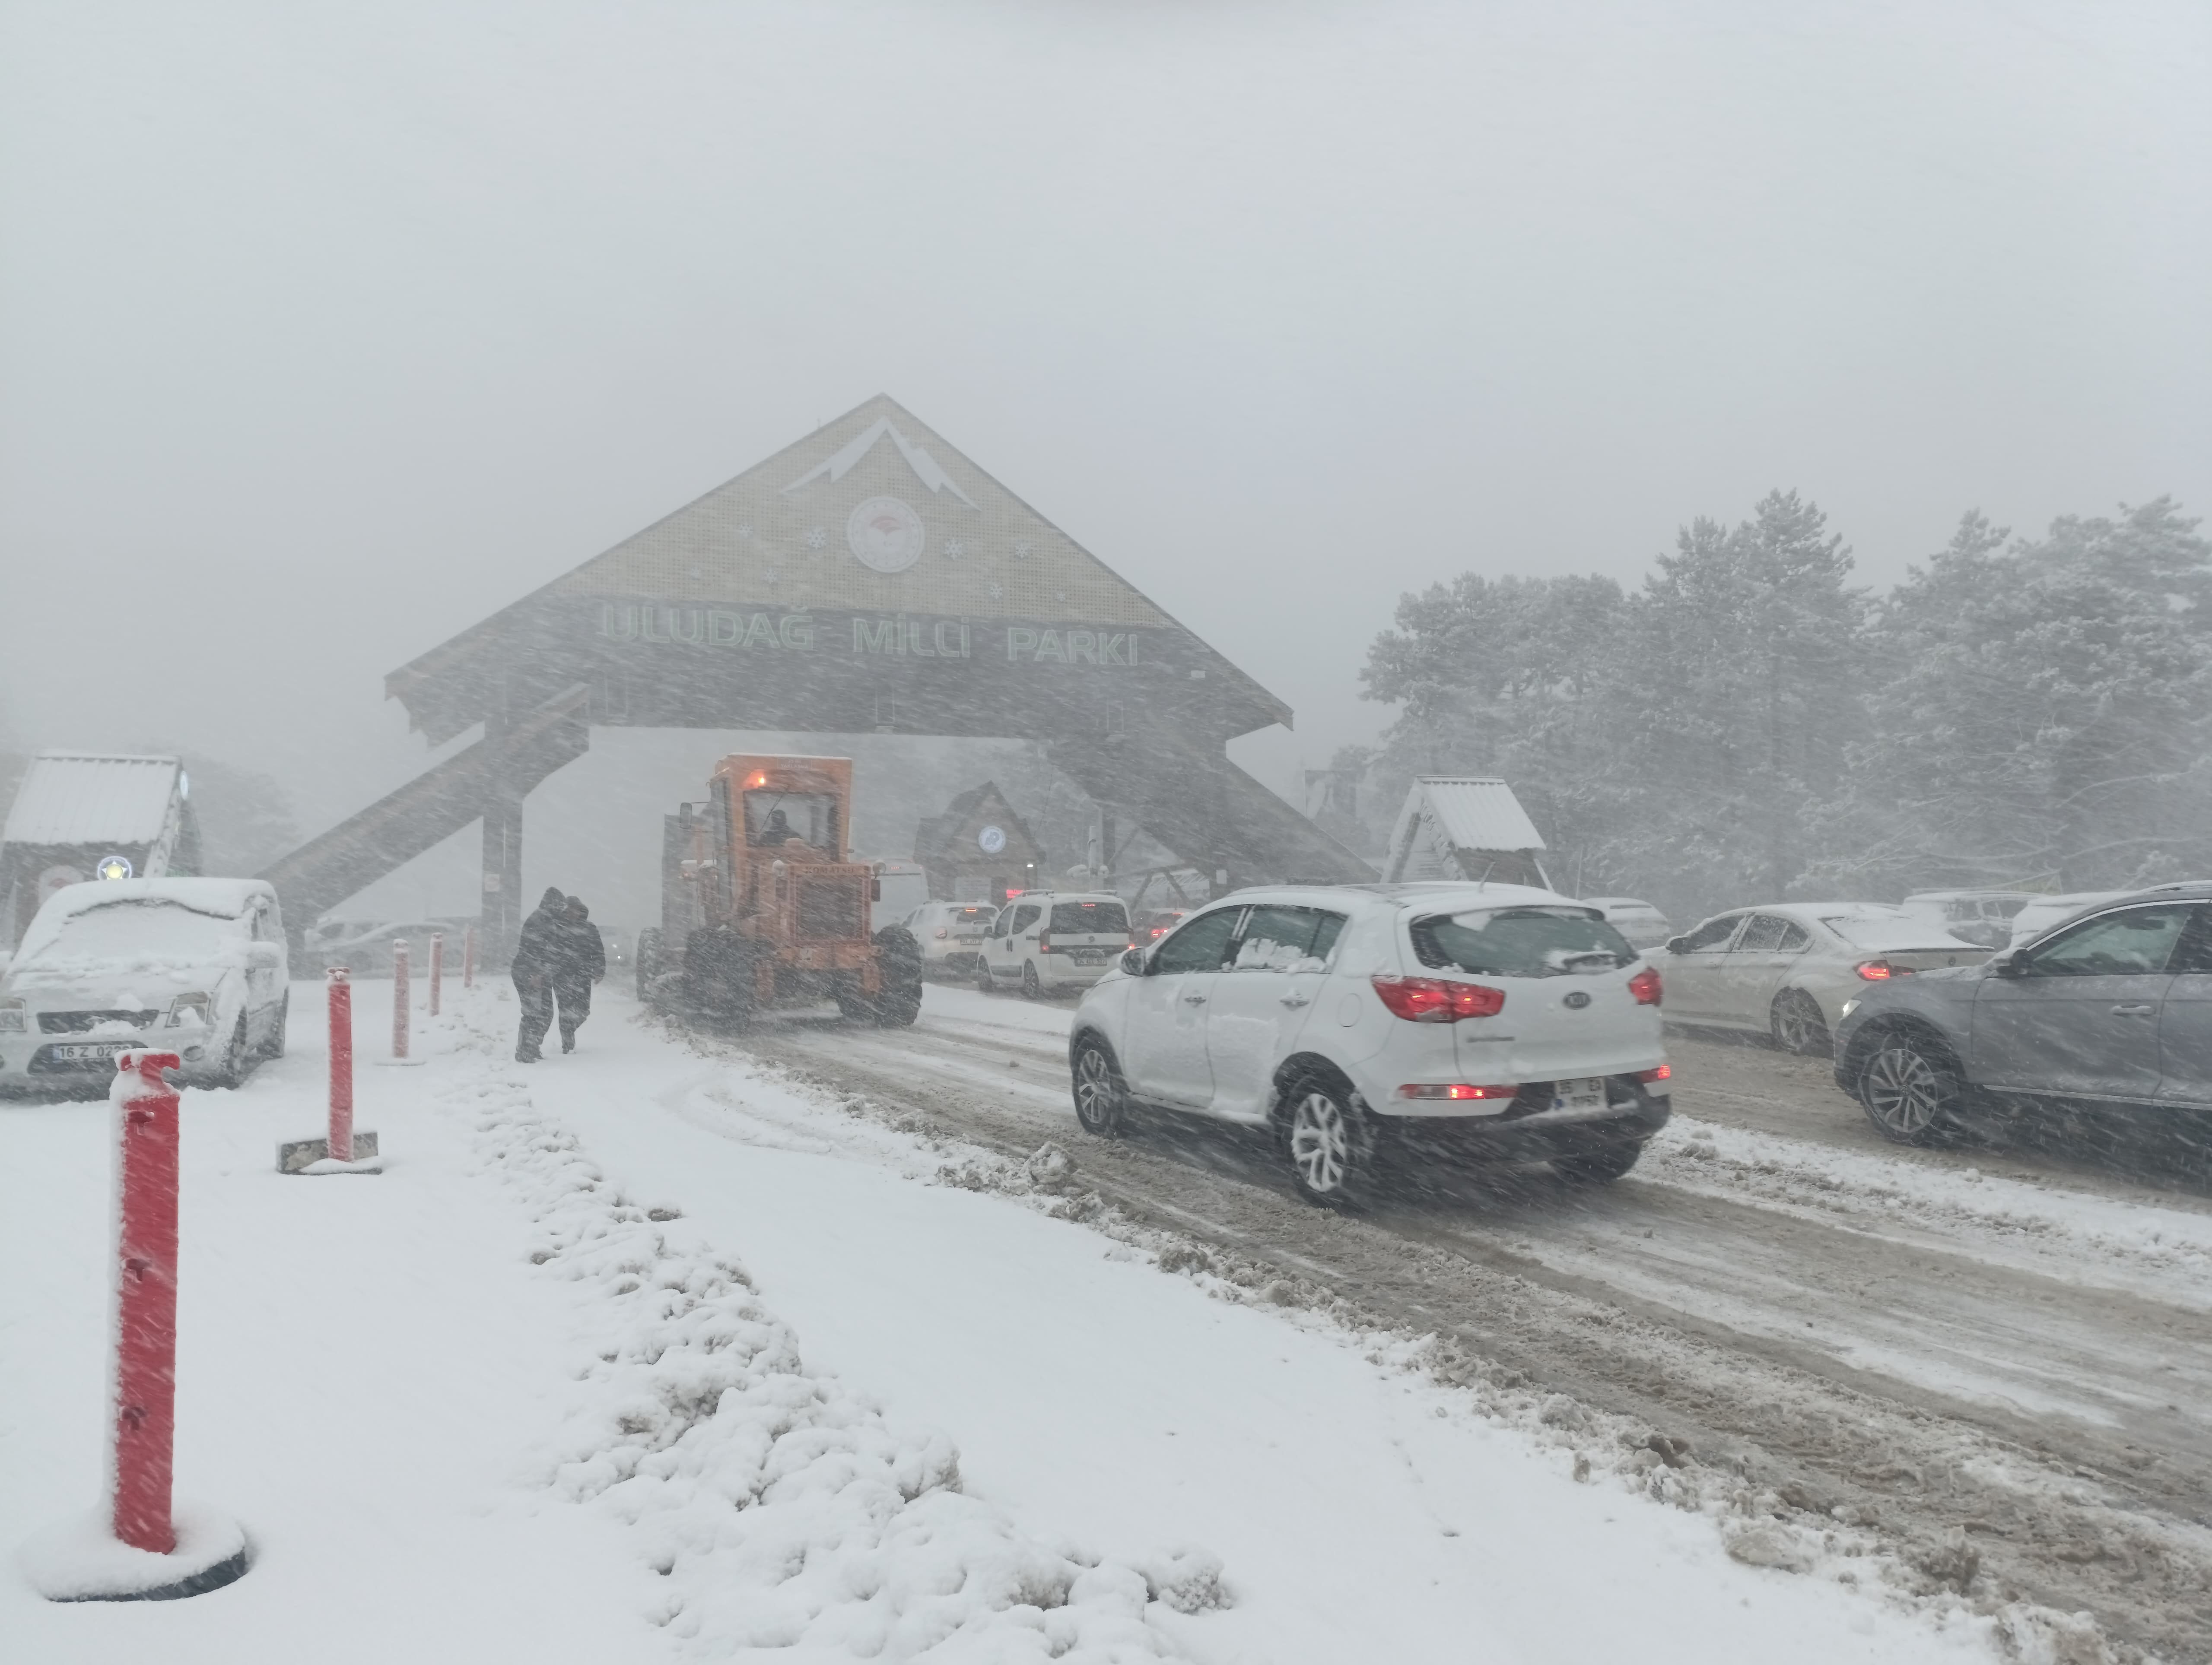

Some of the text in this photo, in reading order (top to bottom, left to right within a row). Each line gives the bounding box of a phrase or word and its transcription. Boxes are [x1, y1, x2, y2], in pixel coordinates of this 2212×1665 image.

[606, 604, 1138, 666] ULUDAĞ MİLLİ PARKI
[60, 1047, 74, 1058] 16
[79, 1047, 89, 1057] Z
